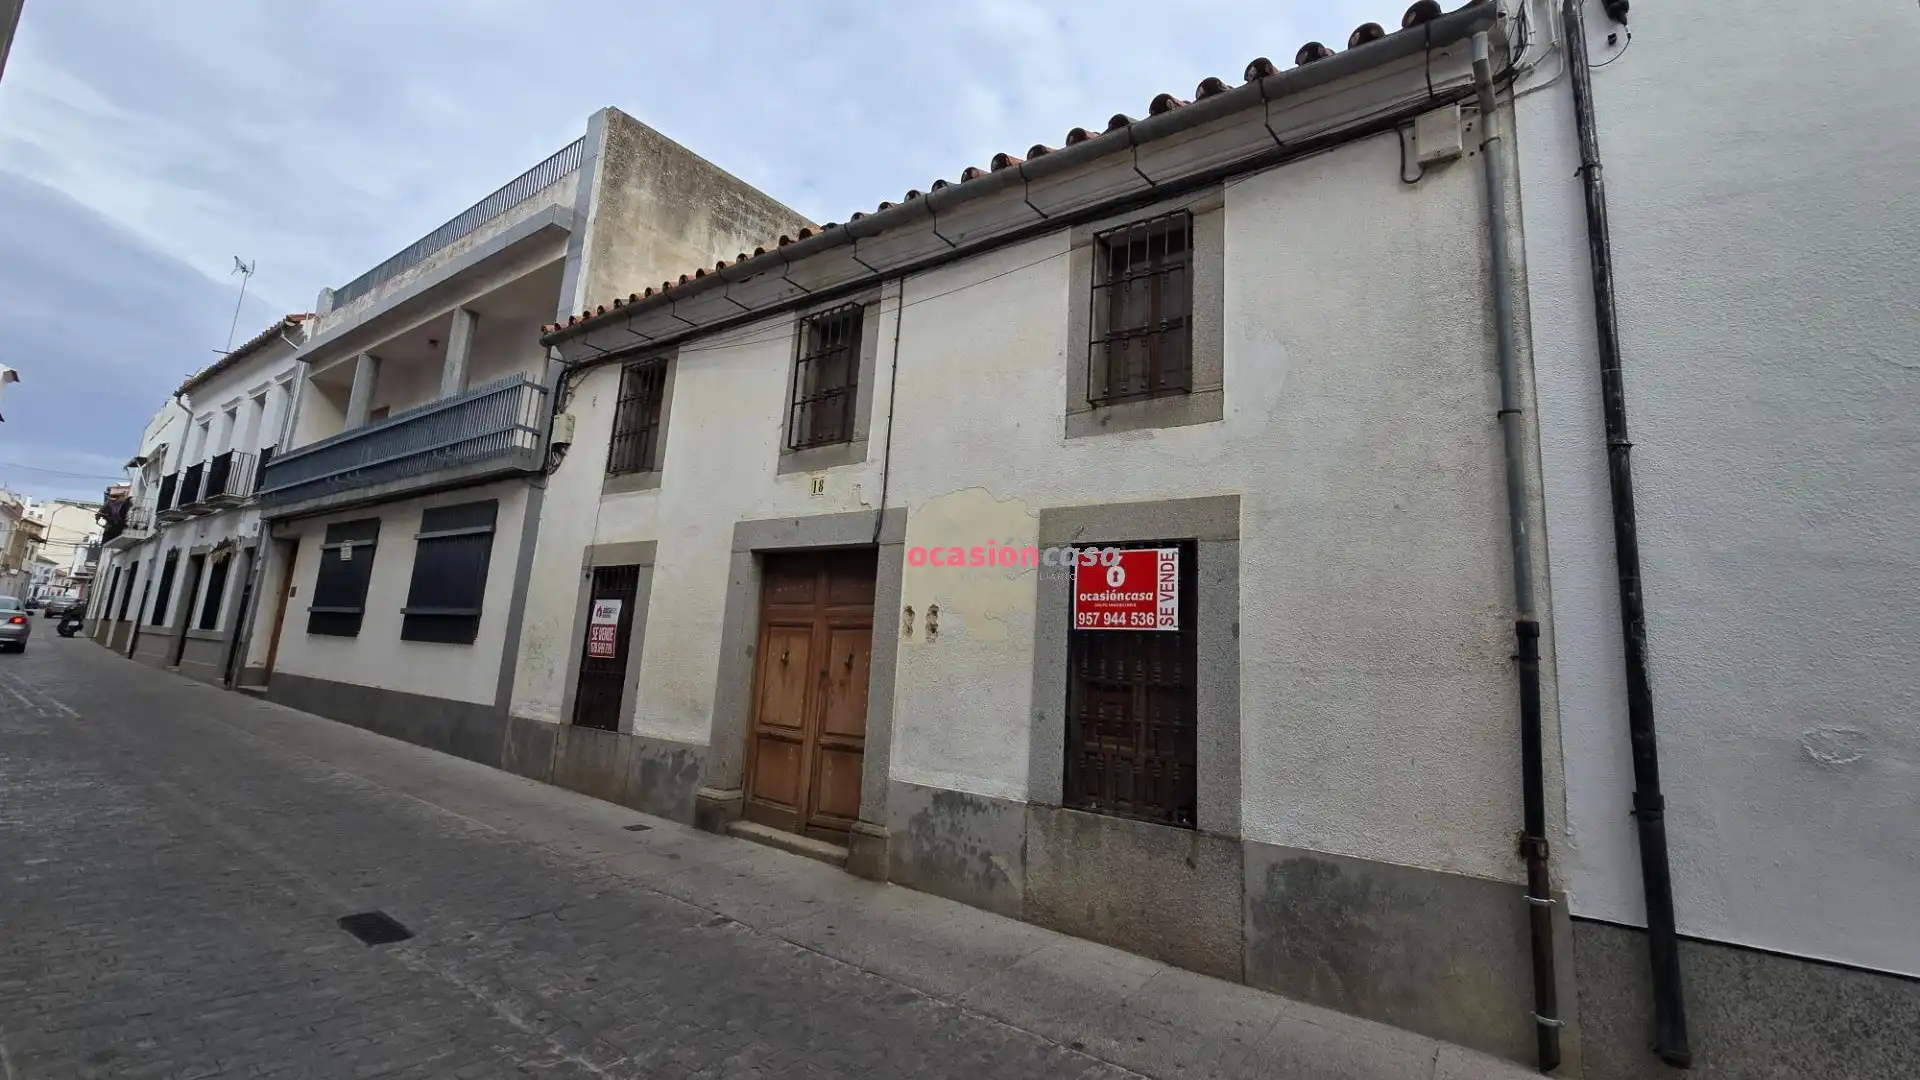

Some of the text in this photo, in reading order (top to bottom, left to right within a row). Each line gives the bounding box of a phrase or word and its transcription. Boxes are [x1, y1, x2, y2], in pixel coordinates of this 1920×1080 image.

[1080, 589, 1154, 602] ocasióncasa
[1160, 552, 1175, 627] SE VENDE
[1078, 611, 1155, 626] 957 944 536
